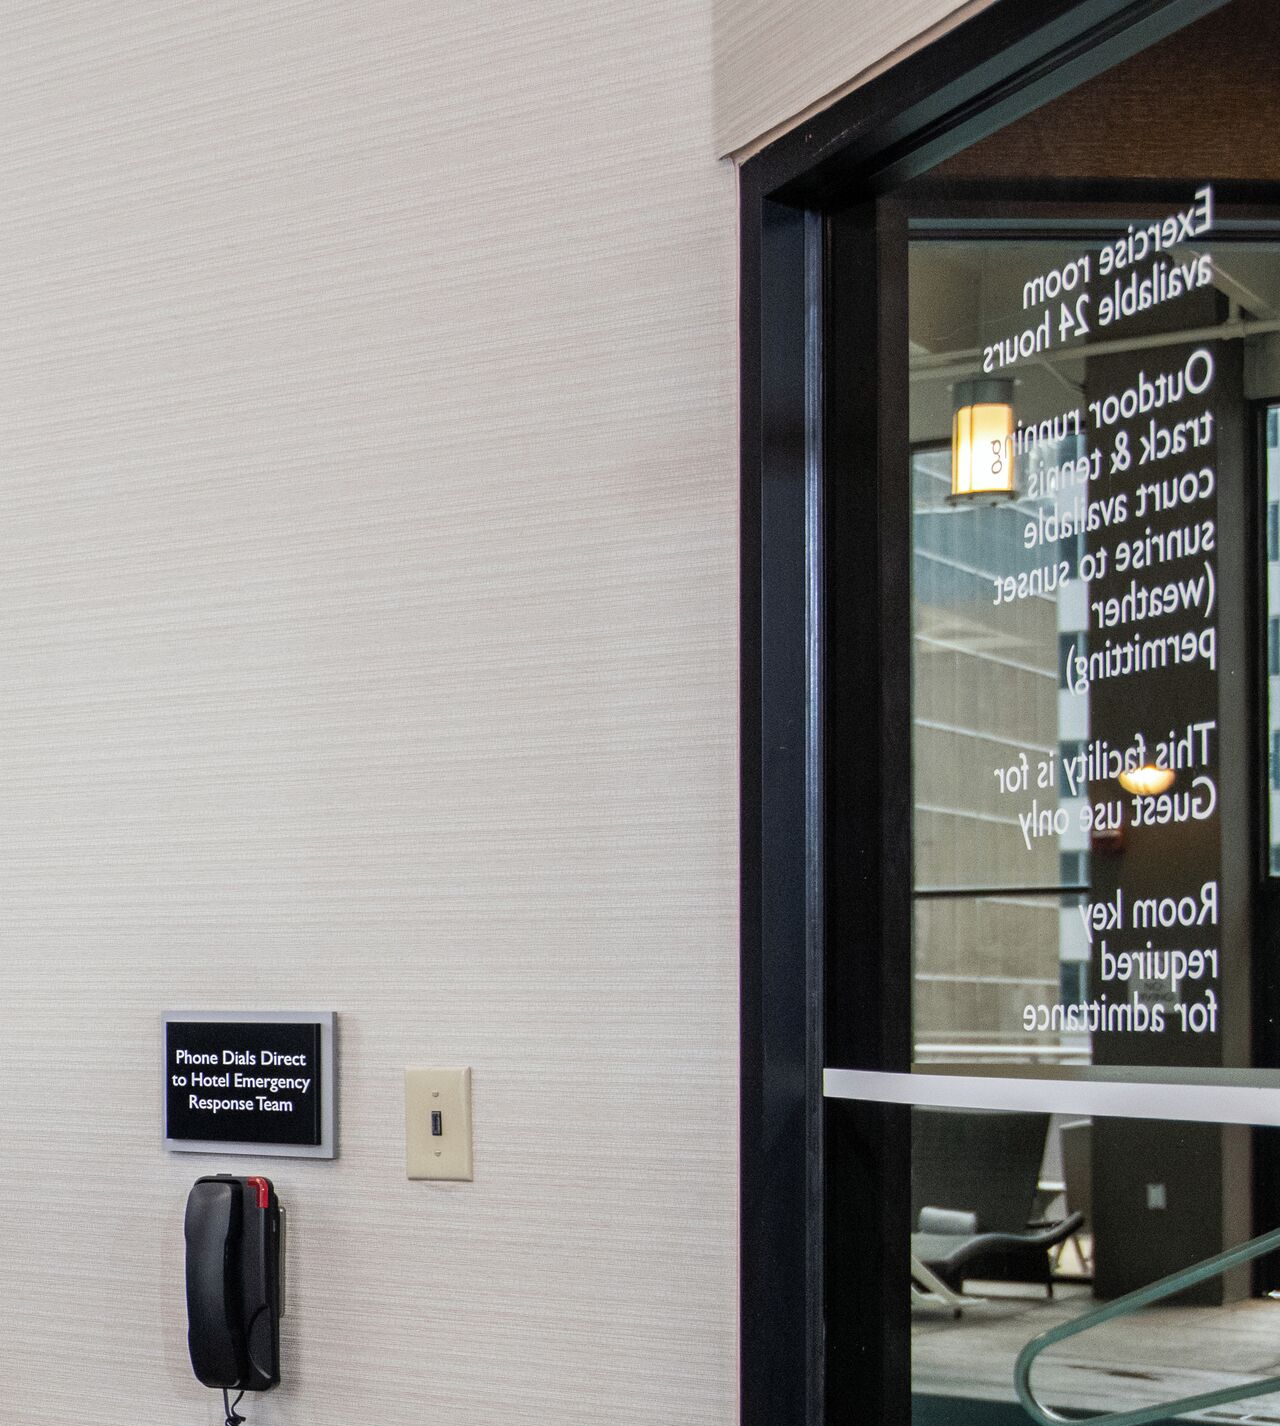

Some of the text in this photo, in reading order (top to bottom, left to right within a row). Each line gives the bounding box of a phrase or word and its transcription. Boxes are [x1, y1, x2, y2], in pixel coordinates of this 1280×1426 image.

[175, 1049, 307, 1067] Phone Dials Direct
[171, 1071, 311, 1094] to Hotel Emergency
[188, 1094, 293, 1114] Response Team
